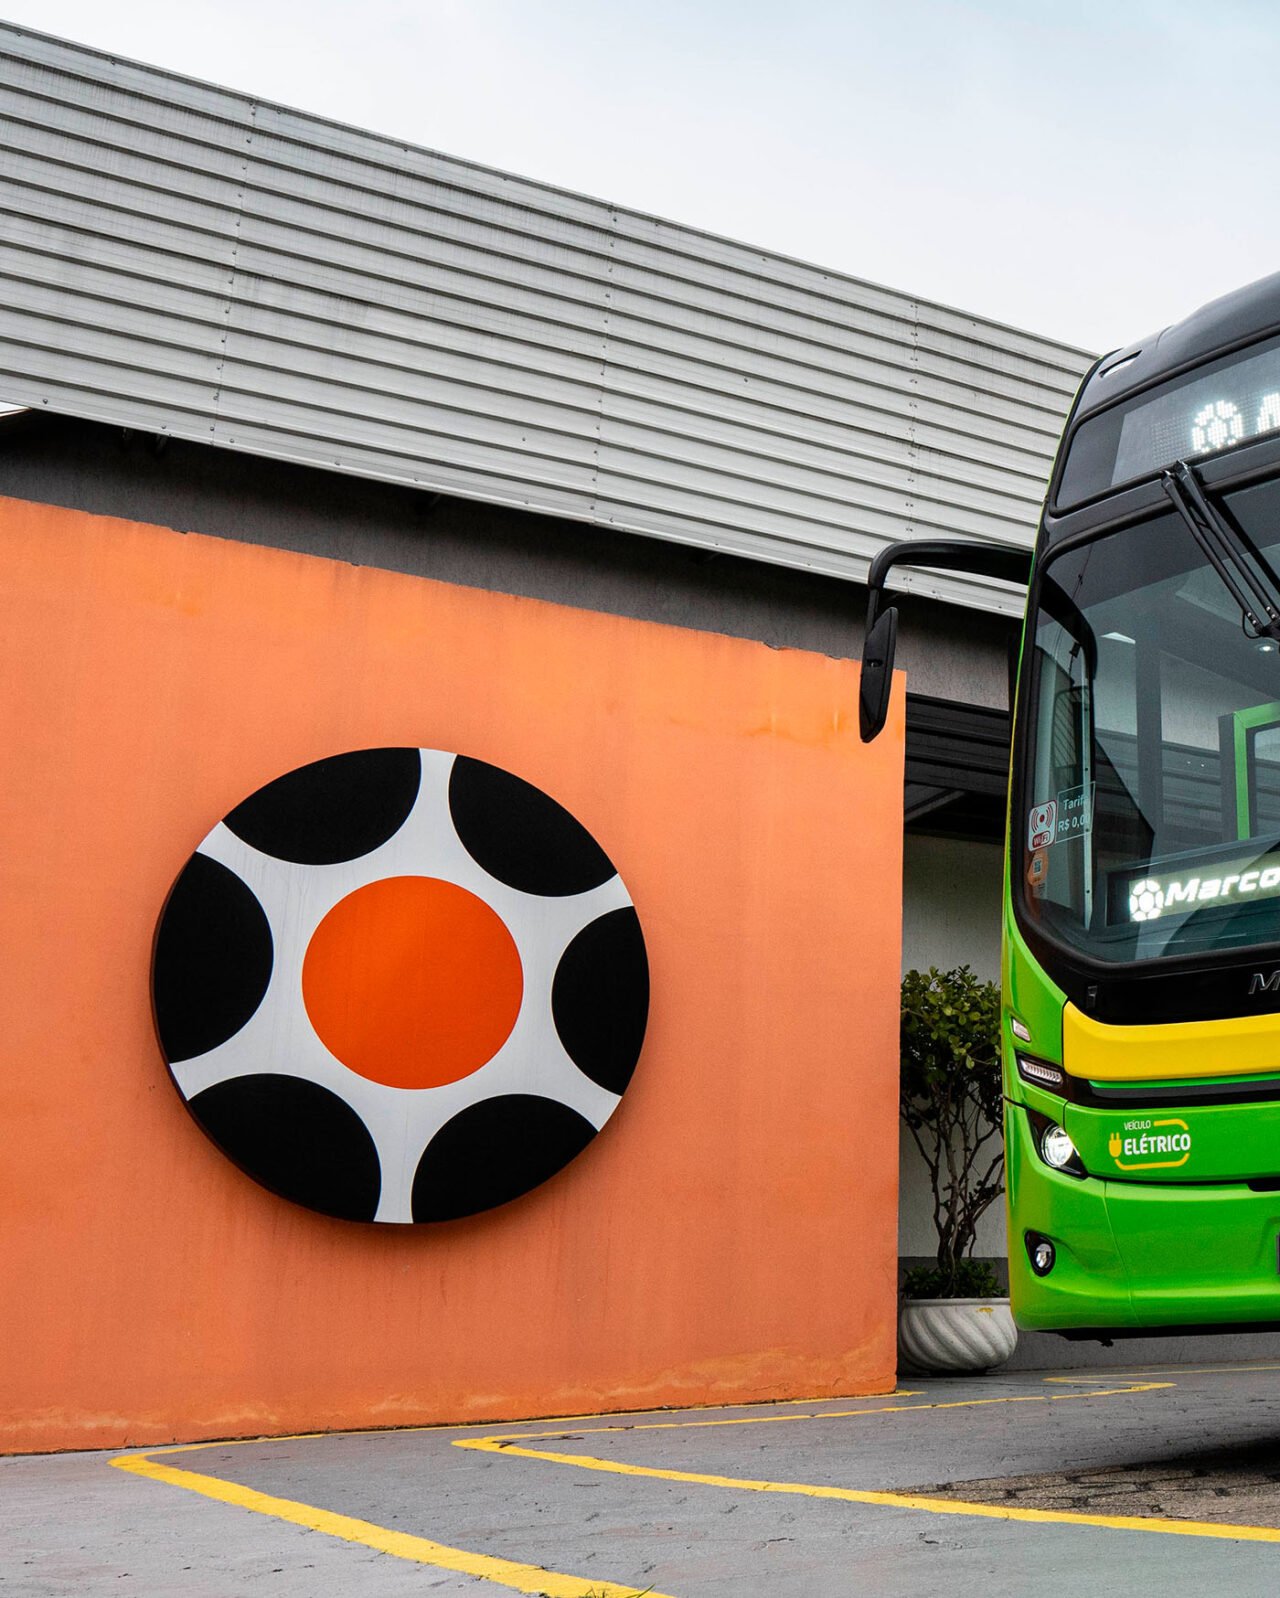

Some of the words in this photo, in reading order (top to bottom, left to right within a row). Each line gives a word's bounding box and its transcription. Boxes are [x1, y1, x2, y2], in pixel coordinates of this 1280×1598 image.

[1058, 818, 1070, 832] R$
[1124, 1120, 1151, 1131] VEÍCULO
[1124, 1133, 1191, 1156] ELÉTRICO
